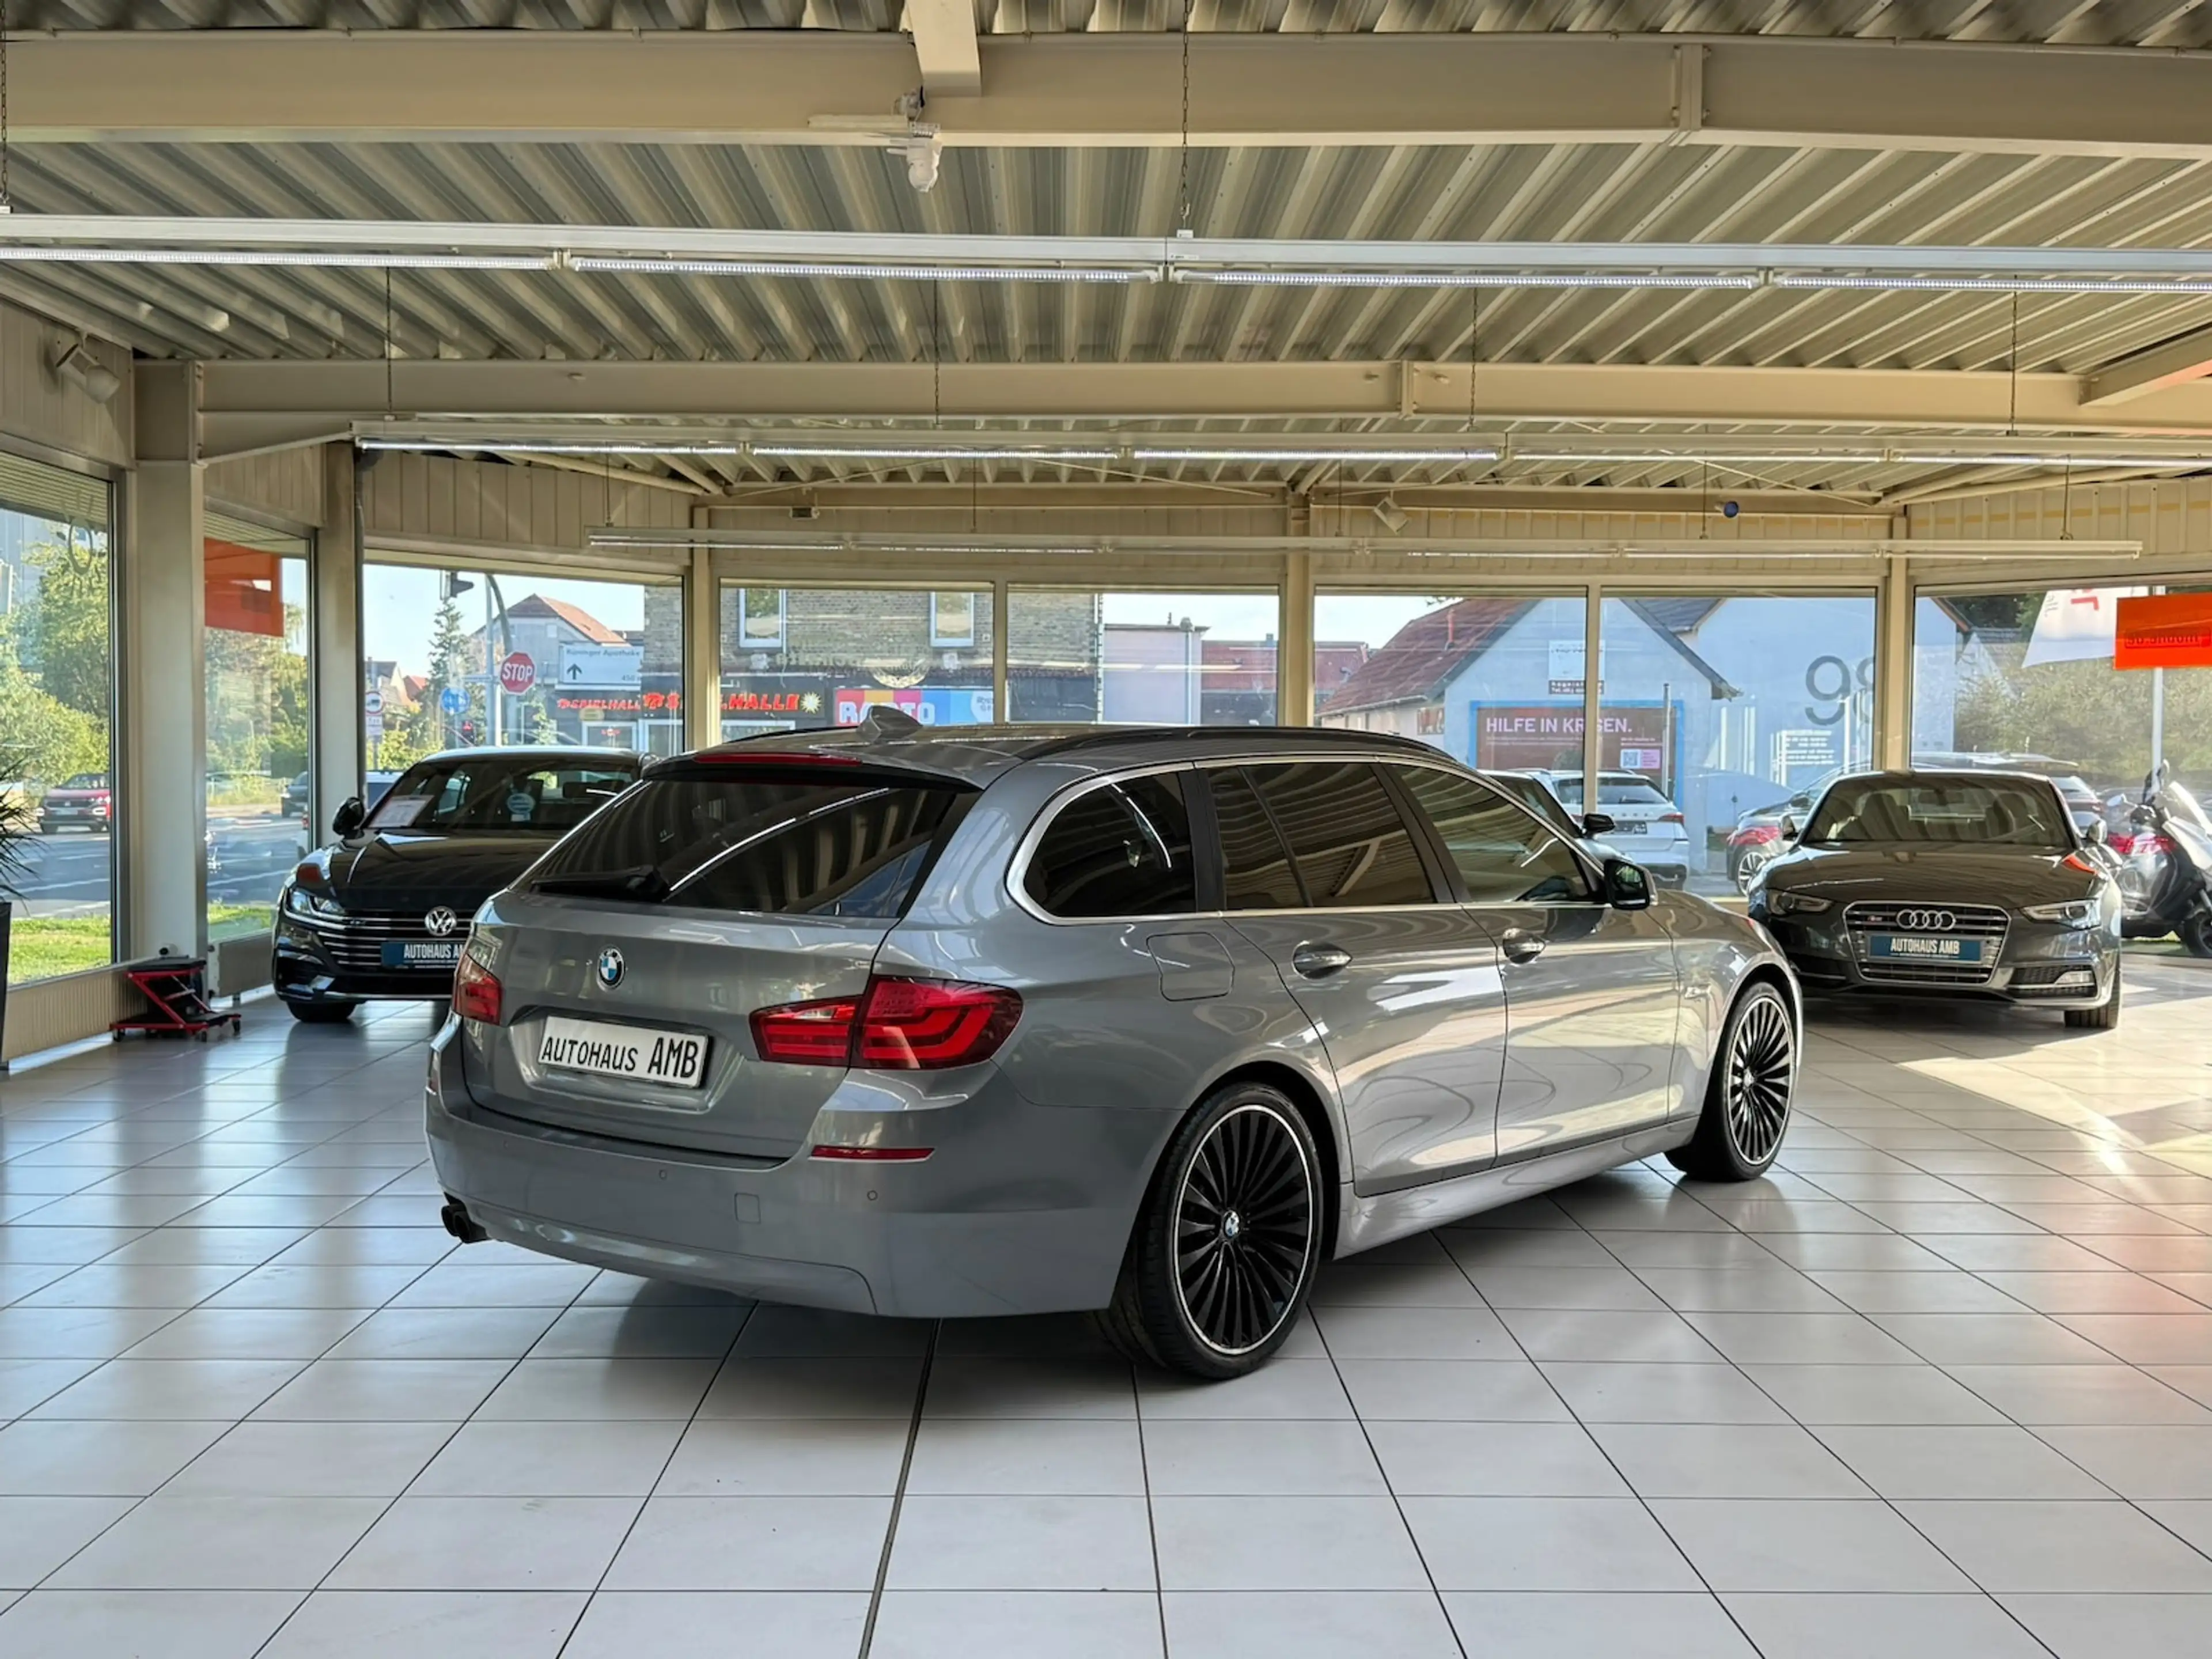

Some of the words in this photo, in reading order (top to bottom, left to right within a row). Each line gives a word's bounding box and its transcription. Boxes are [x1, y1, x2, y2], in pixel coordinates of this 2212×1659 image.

[502, 662, 533, 682] STOP
[570, 698, 641, 710] SPIELHALL
[1486, 717, 1536, 733] HILFE
[1540, 717, 1558, 733] IN
[1562, 717, 1633, 733] KRSEN.
[404, 944, 452, 959] AUTOHAUS
[1890, 937, 1938, 953] AUTOHAUS
[1938, 940, 1960, 955] AMB
[541, 1036, 639, 1071] AUTOHAUS
[647, 1037, 699, 1078] AMB
